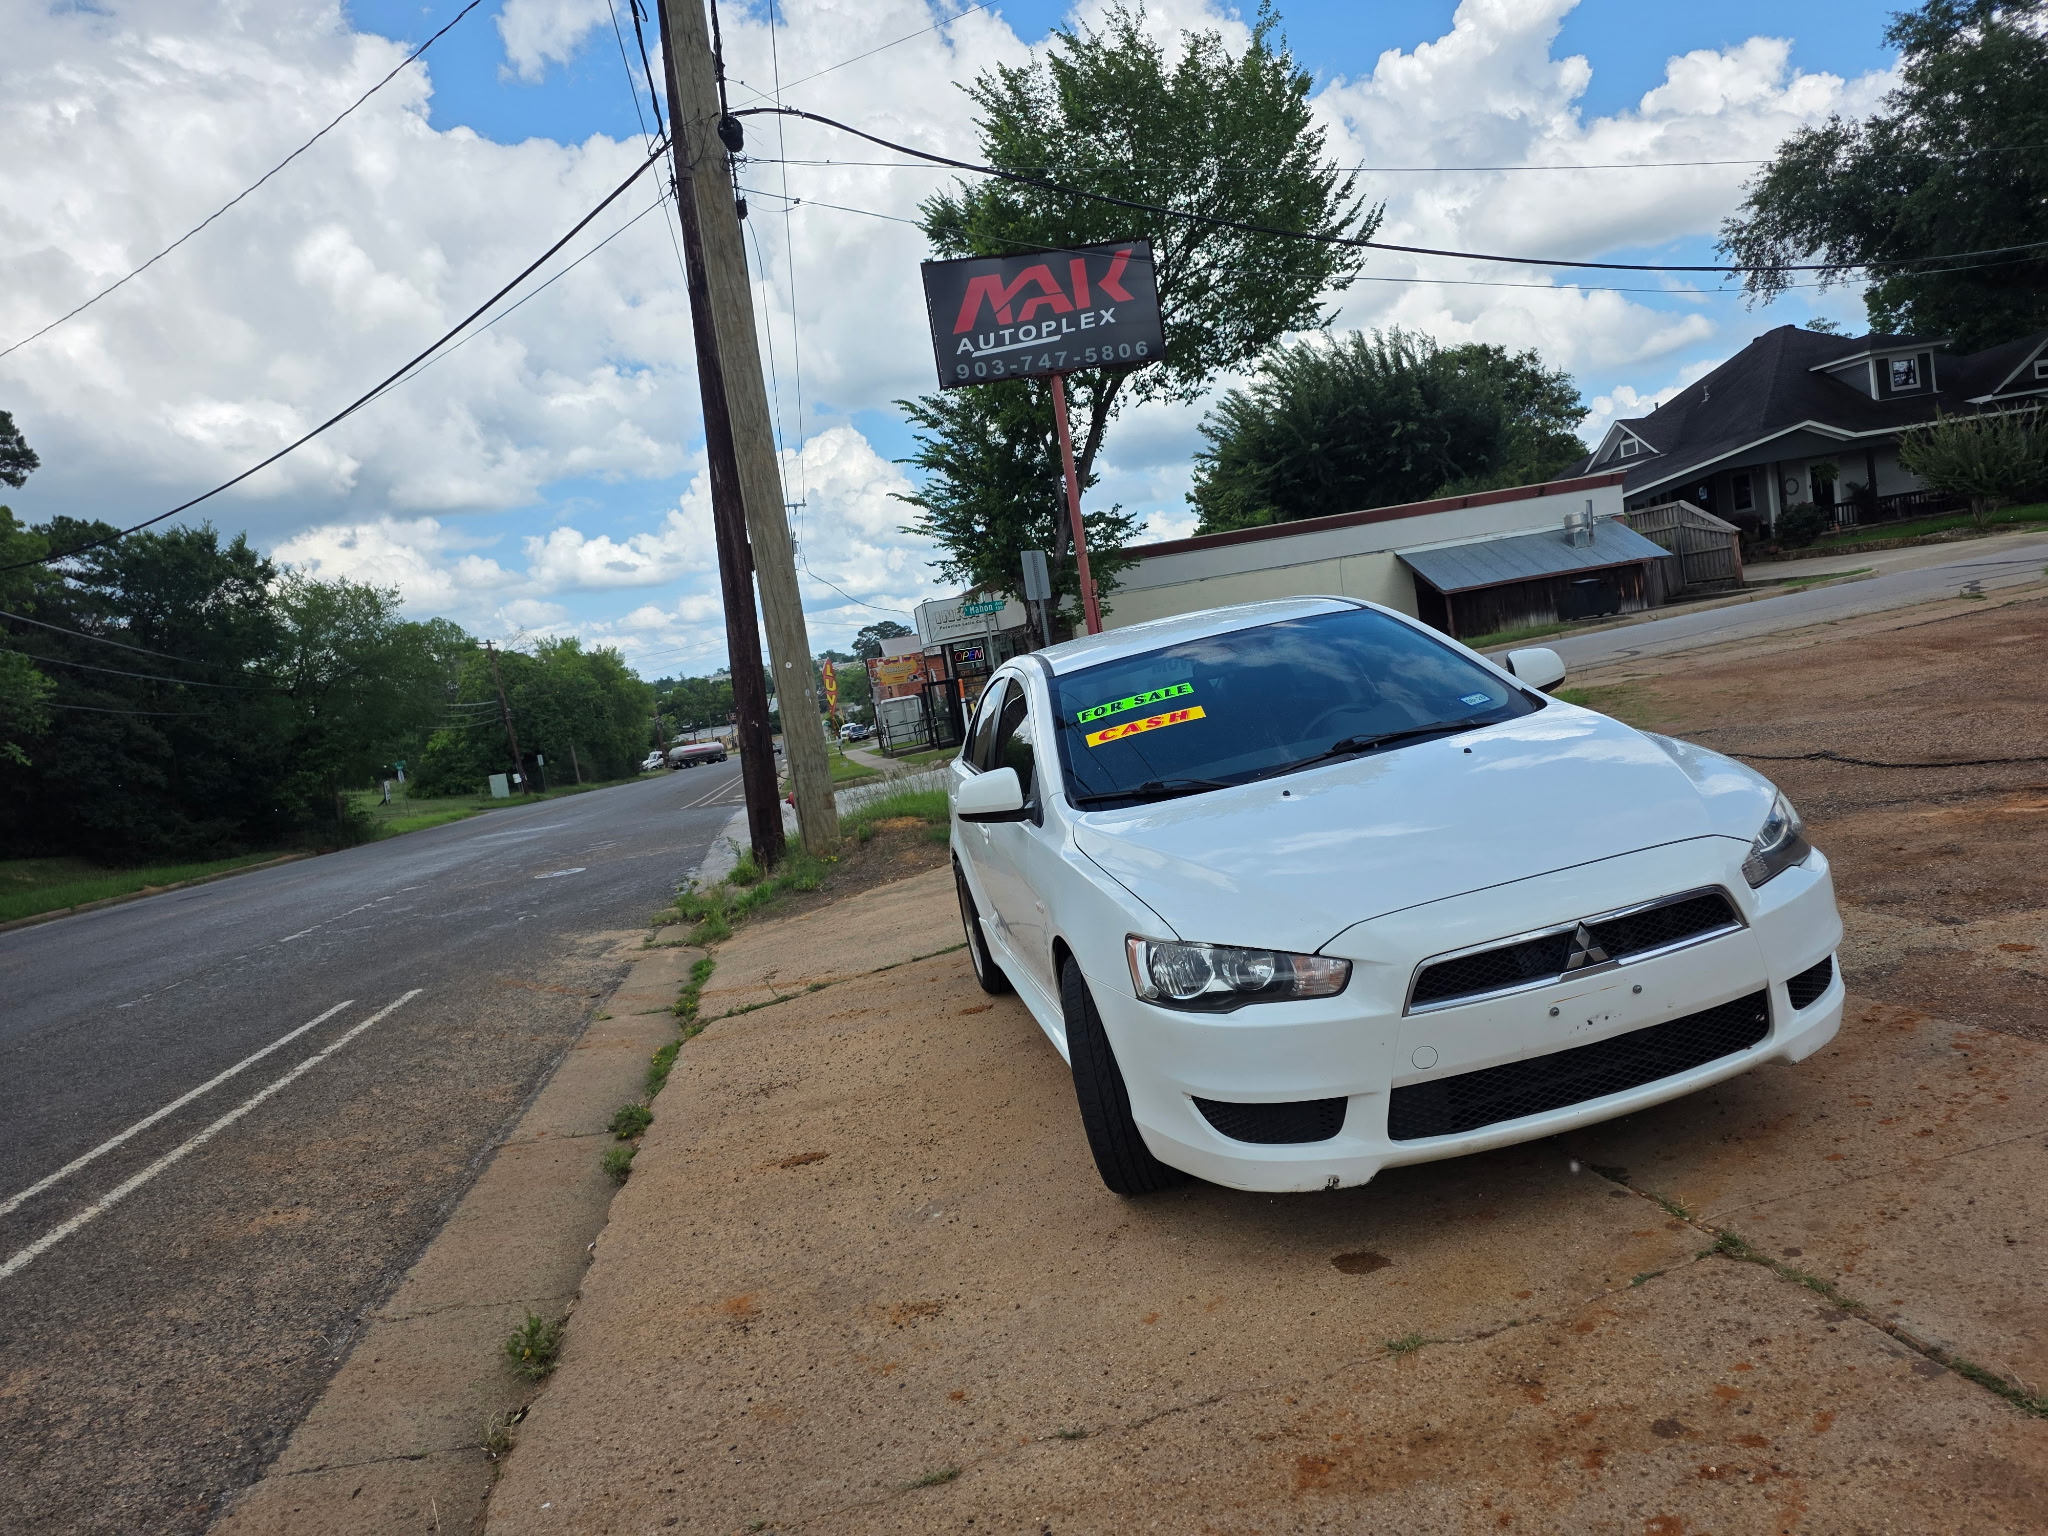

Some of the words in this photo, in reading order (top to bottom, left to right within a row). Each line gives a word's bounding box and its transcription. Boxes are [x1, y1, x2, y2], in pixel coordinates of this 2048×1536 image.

[953, 248, 1135, 335] MAK
[956, 307, 1116, 355] AUTOPLEX
[956, 340, 1149, 380] 903-747-5806
[969, 604, 994, 615] Mahon
[954, 649, 982, 662] OPEN
[1081, 701, 1123, 722] FOR
[1134, 684, 1189, 706] SALE
[1098, 709, 1190, 741] CASH
